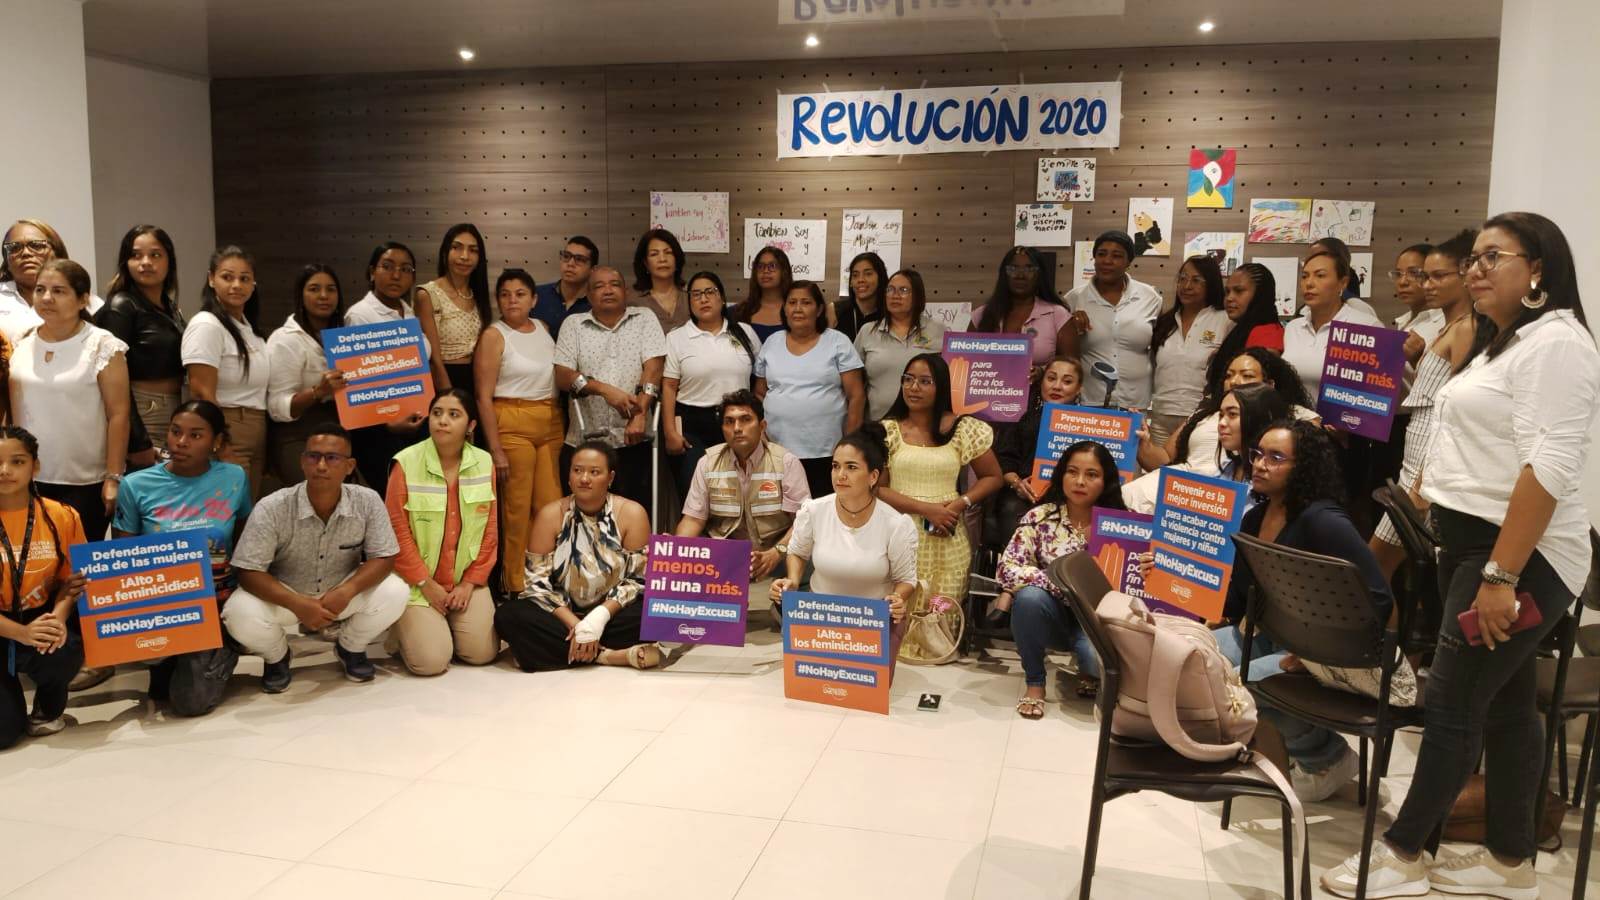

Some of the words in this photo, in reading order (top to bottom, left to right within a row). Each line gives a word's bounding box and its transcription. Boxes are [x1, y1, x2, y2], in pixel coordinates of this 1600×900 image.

[1040, 98, 1106, 136] 2020
[792, 264, 810, 274] cesos
[938, 308, 958, 322] SOY
[330, 345, 351, 354] vida
[368, 340, 380, 348] las
[382, 335, 419, 347] mujeres
[338, 328, 398, 343] Defendamos
[1332, 328, 1347, 342] Ni
[1350, 334, 1375, 348] una
[950, 341, 1025, 352] #NoHayExcusa
[358, 357, 418, 376] feminicidios!
[361, 355, 384, 366] ¡Alto
[971, 361, 992, 369] para
[1330, 346, 1380, 368] menos,
[970, 370, 998, 378] poner
[1326, 364, 1338, 376] ni
[1340, 368, 1364, 382] una
[1366, 372, 1396, 389] más.
[350, 384, 422, 403] #NoHayExcusa
[969, 386, 1024, 396] feminicidios
[1325, 388, 1388, 412] #NoHayExcusa
[1055, 422, 1080, 433] mejor
[1083, 424, 1124, 437] inversión
[1060, 414, 1098, 424] Prevenir
[1112, 418, 1120, 427] la
[1054, 436, 1072, 444] para
[1105, 442, 1122, 450] con
[1172, 481, 1205, 498] Prevenir
[1206, 490, 1216, 499] es
[1218, 492, 1225, 502] la
[1167, 493, 1190, 506] mejor
[1191, 496, 1228, 516] inversión
[1102, 520, 1152, 538] #NoHay
[1166, 510, 1181, 520] para
[1182, 513, 1207, 528] acabar
[1208, 524, 1224, 532] con
[1161, 519, 1168, 528] la
[1168, 520, 1198, 538] violencia
[1200, 531, 1226, 546] contra
[92, 543, 174, 561] Defendamos
[176, 540, 188, 550] la
[654, 541, 673, 557] Ni
[678, 544, 710, 560] una
[1164, 532, 1190, 546] mujeres
[1192, 541, 1196, 550] y
[1198, 540, 1218, 555] niñas
[80, 563, 109, 576] vida
[112, 559, 128, 570] de
[132, 556, 150, 567] las
[153, 550, 203, 565] mujeres
[652, 560, 720, 579] menos,
[1154, 551, 1220, 586] #NoHayExcusa
[121, 574, 153, 588] ¡Alto
[156, 572, 165, 581] a
[651, 577, 666, 590] ni
[671, 580, 700, 593] una
[706, 580, 742, 596] más.
[1126, 573, 1141, 584] fin
[92, 594, 112, 606] los
[115, 578, 200, 601] feminicidios!
[652, 602, 737, 618] #NoHayExcusa
[798, 599, 862, 614] Defendamos
[864, 605, 874, 616] la
[101, 610, 200, 634] #NoHayExcusa
[788, 610, 810, 620] vida
[812, 612, 824, 621] de
[827, 613, 842, 623] las
[844, 617, 884, 628] mujeres
[816, 628, 840, 640] ¡Alto
[842, 632, 851, 640] a
[794, 638, 810, 648] los
[812, 639, 878, 654] feminicidios!
[798, 663, 874, 684] #NoHayExcusa
